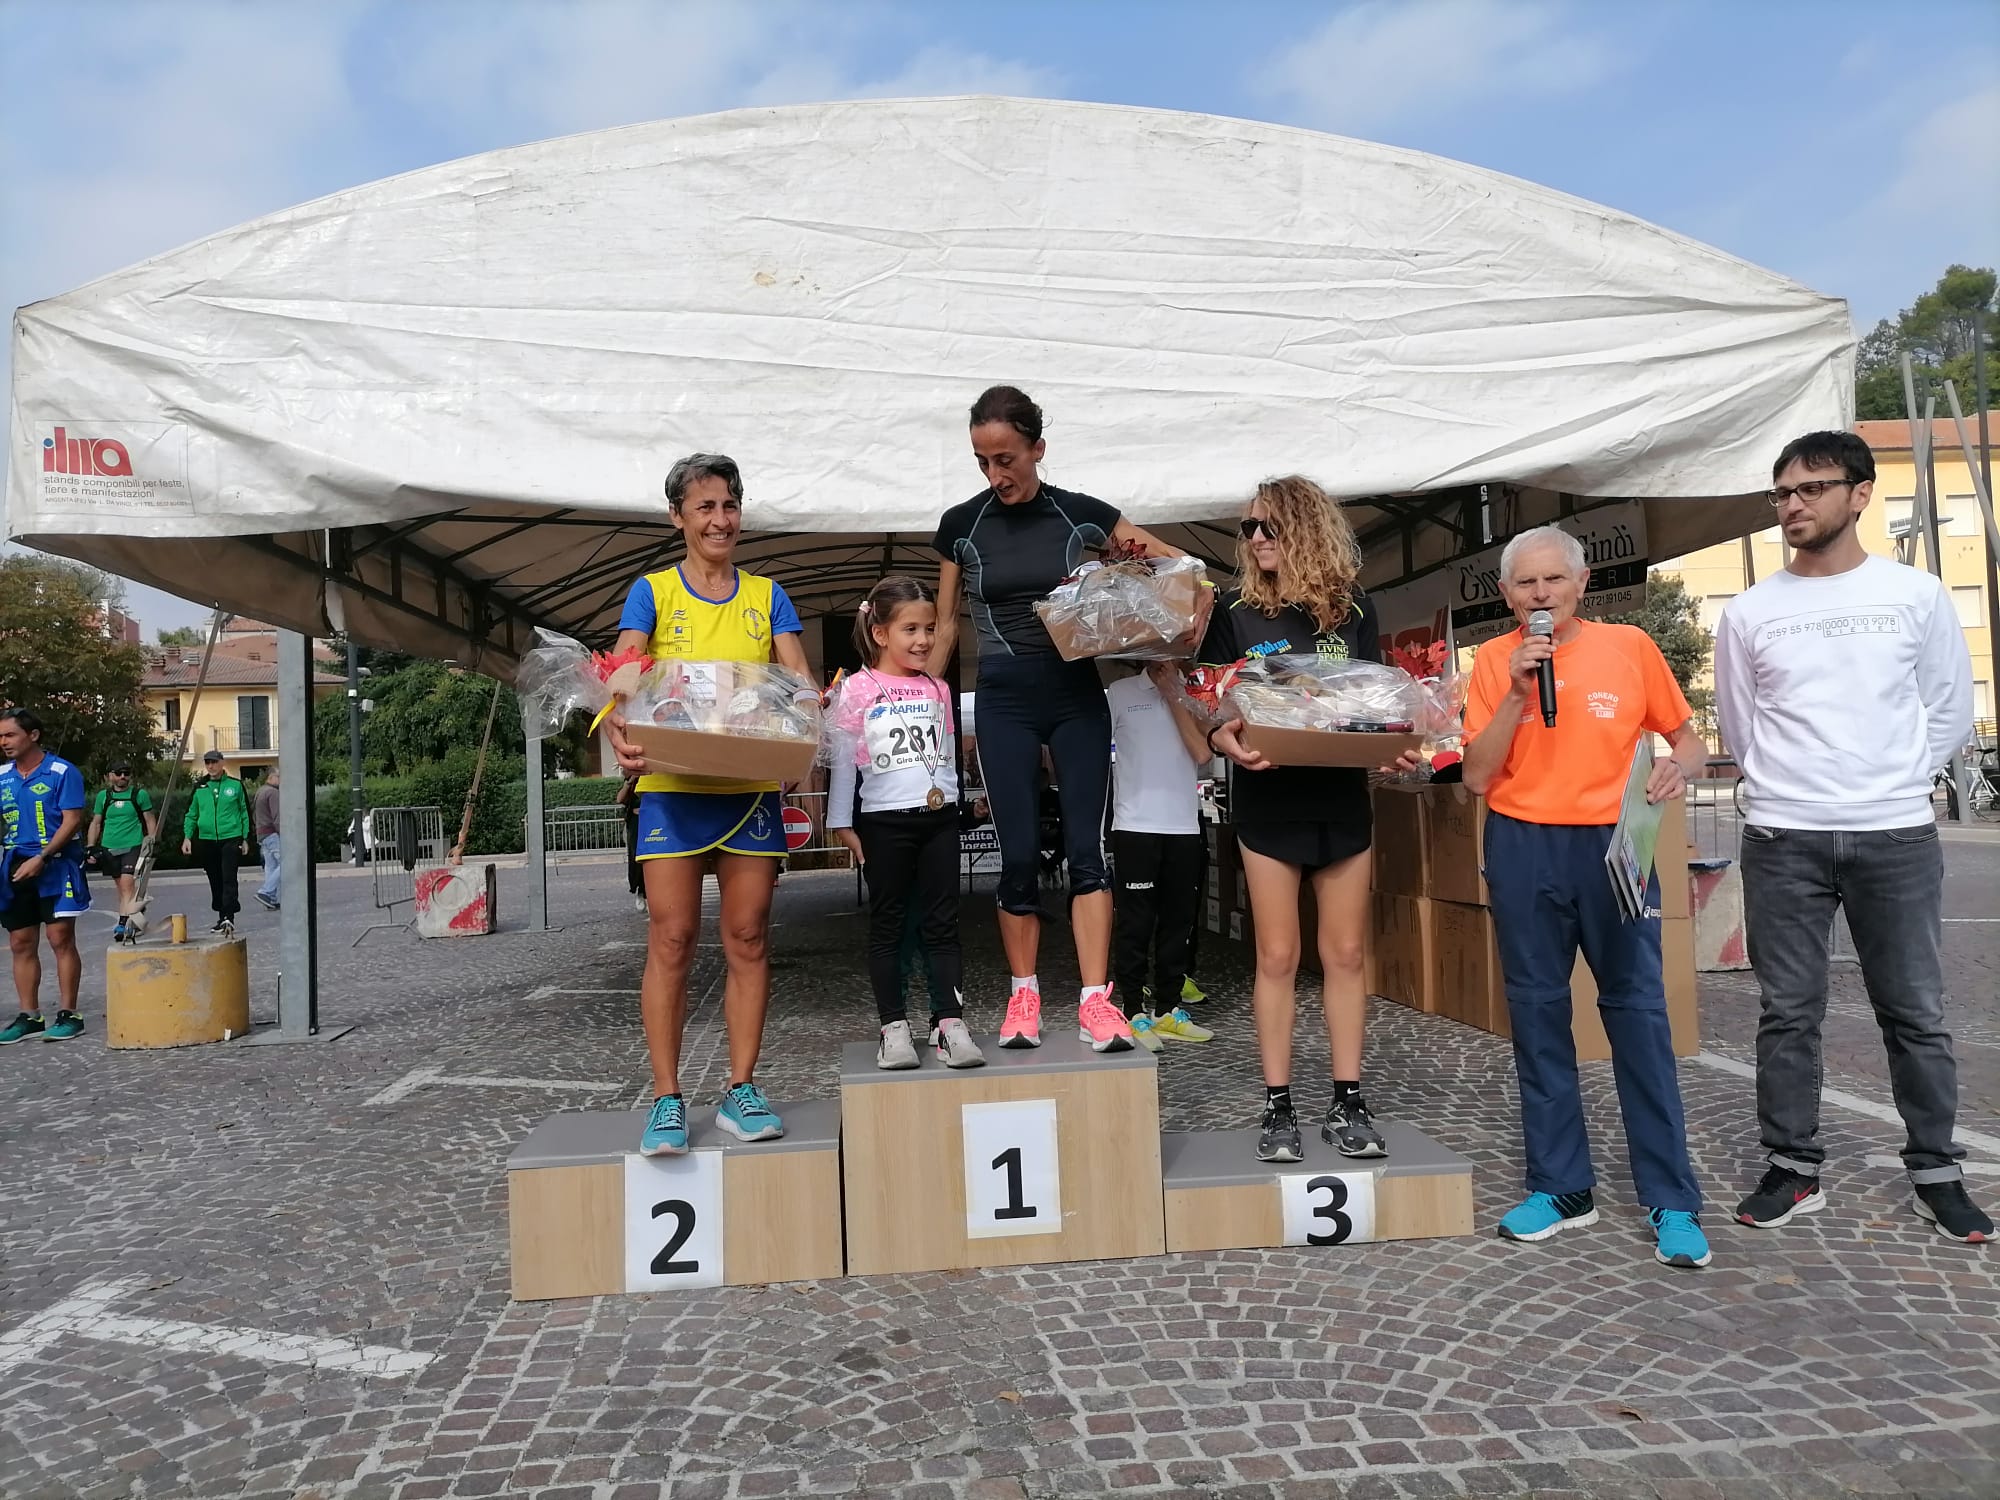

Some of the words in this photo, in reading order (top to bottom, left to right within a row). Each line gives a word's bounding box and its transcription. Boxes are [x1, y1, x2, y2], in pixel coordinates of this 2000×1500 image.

[43, 475, 80, 485] stands
[83, 479, 141, 490] componibili
[142, 480, 158, 490] per
[45, 484, 68, 494] fiere
[71, 487, 78, 495] e
[81, 488, 155, 498] manifestazioni
[1766, 627, 1787, 640] 0159
[1790, 624, 1802, 635] 55
[1804, 622, 1822, 632] 978
[1852, 617, 1869, 626] 100
[1871, 617, 1896, 626] 9078
[1316, 645, 1349, 654] LIVING
[1318, 652, 1348, 662] SPORT
[890, 687, 924, 696] NEVER
[889, 703, 929, 715] KARHU
[889, 724, 939, 756] 281
[896, 755, 913, 765] Giro
[959, 832, 993, 841] ndita
[960, 840, 999, 850] logeri
[991, 1147, 1037, 1220] 1
[1306, 1175, 1352, 1246] 3
[650, 1199, 700, 1275] 2
